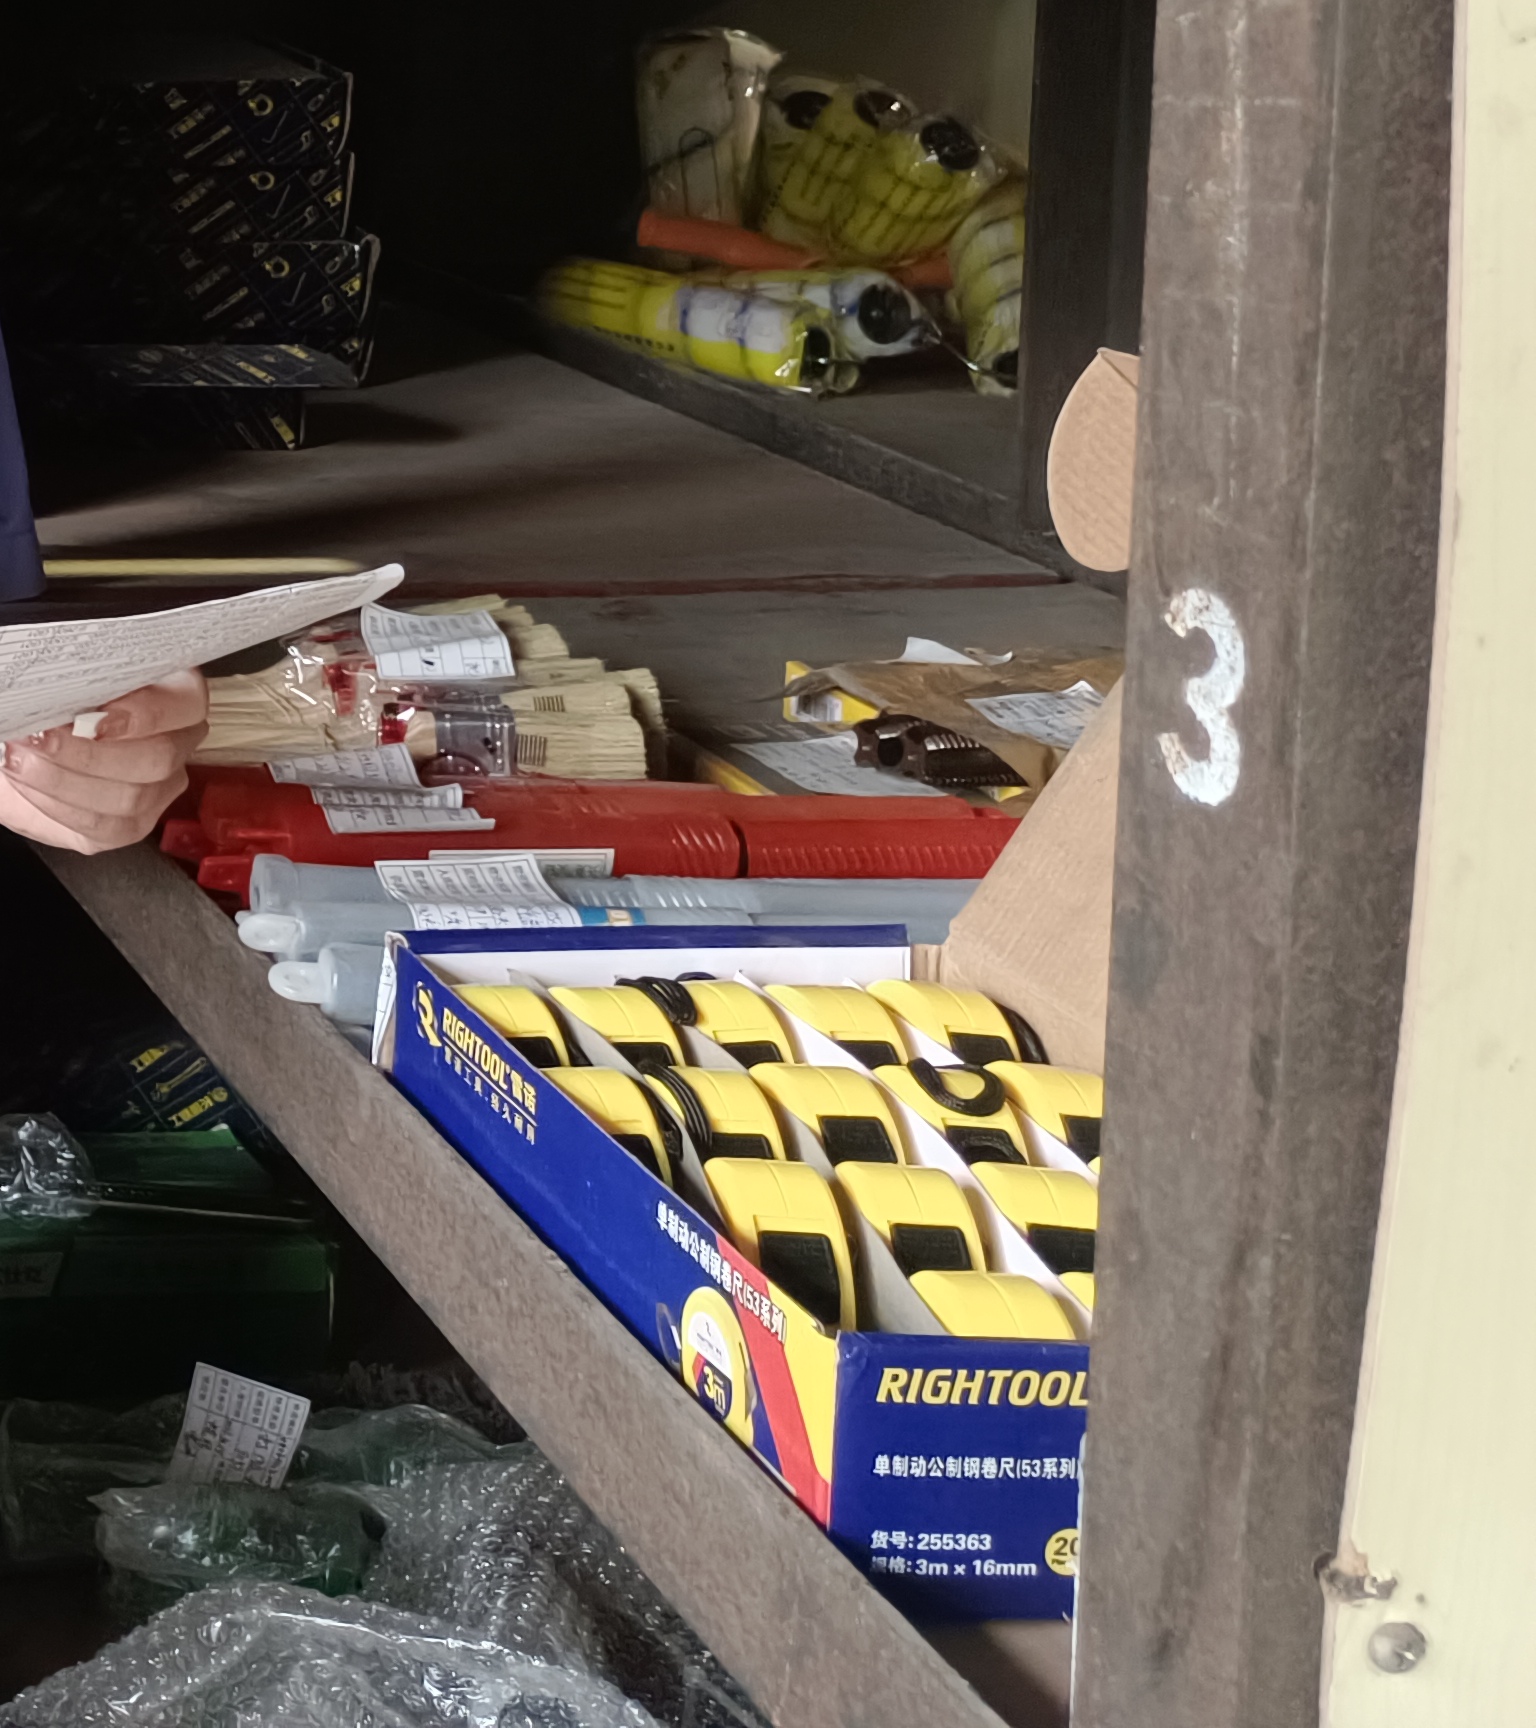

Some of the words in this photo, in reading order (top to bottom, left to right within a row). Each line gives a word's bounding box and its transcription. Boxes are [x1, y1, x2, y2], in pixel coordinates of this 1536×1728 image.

[1158, 587, 1245, 807] 3
[443, 1007, 508, 1091] RIGHTOOL
[876, 1367, 1089, 1407] RIGHTOOL
[872, 1454, 1079, 1480] 单制动公制钢卷尺(53系列
[972, 1559, 1037, 1576] 16mm
